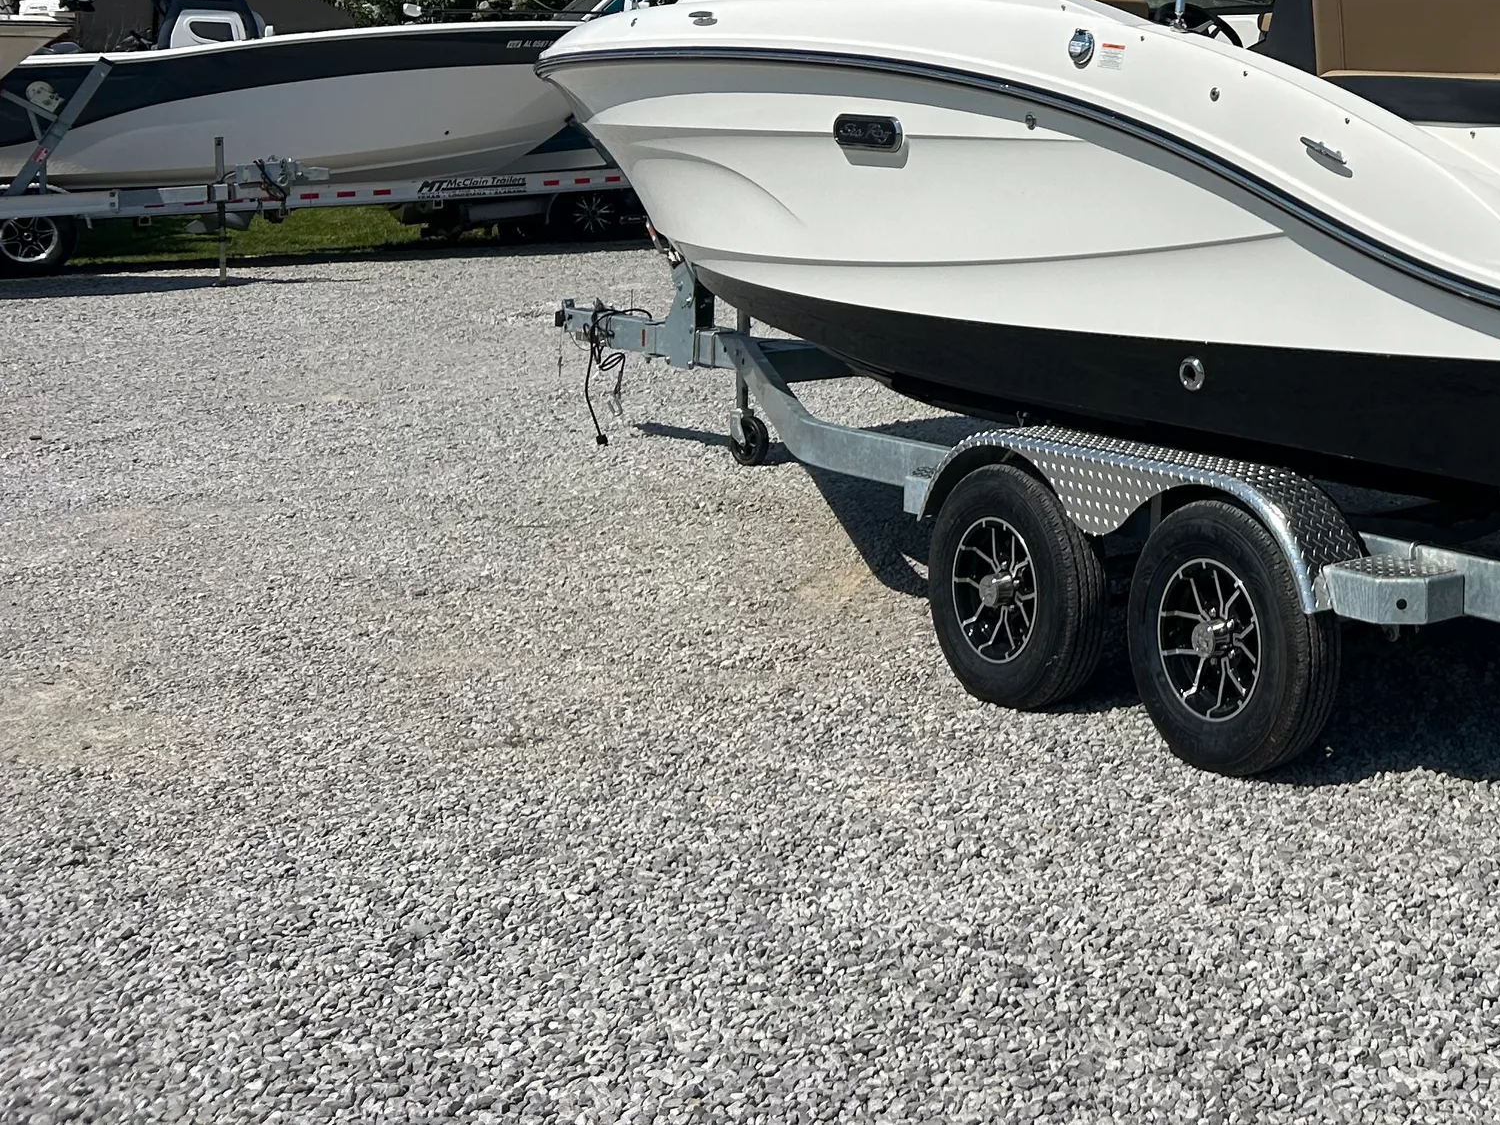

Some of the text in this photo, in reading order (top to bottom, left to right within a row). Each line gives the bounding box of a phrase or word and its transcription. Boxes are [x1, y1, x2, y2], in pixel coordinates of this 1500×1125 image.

[839, 122, 892, 144] Sea Ray
[446, 177, 489, 188] McClain
[491, 176, 527, 186] Trailers
